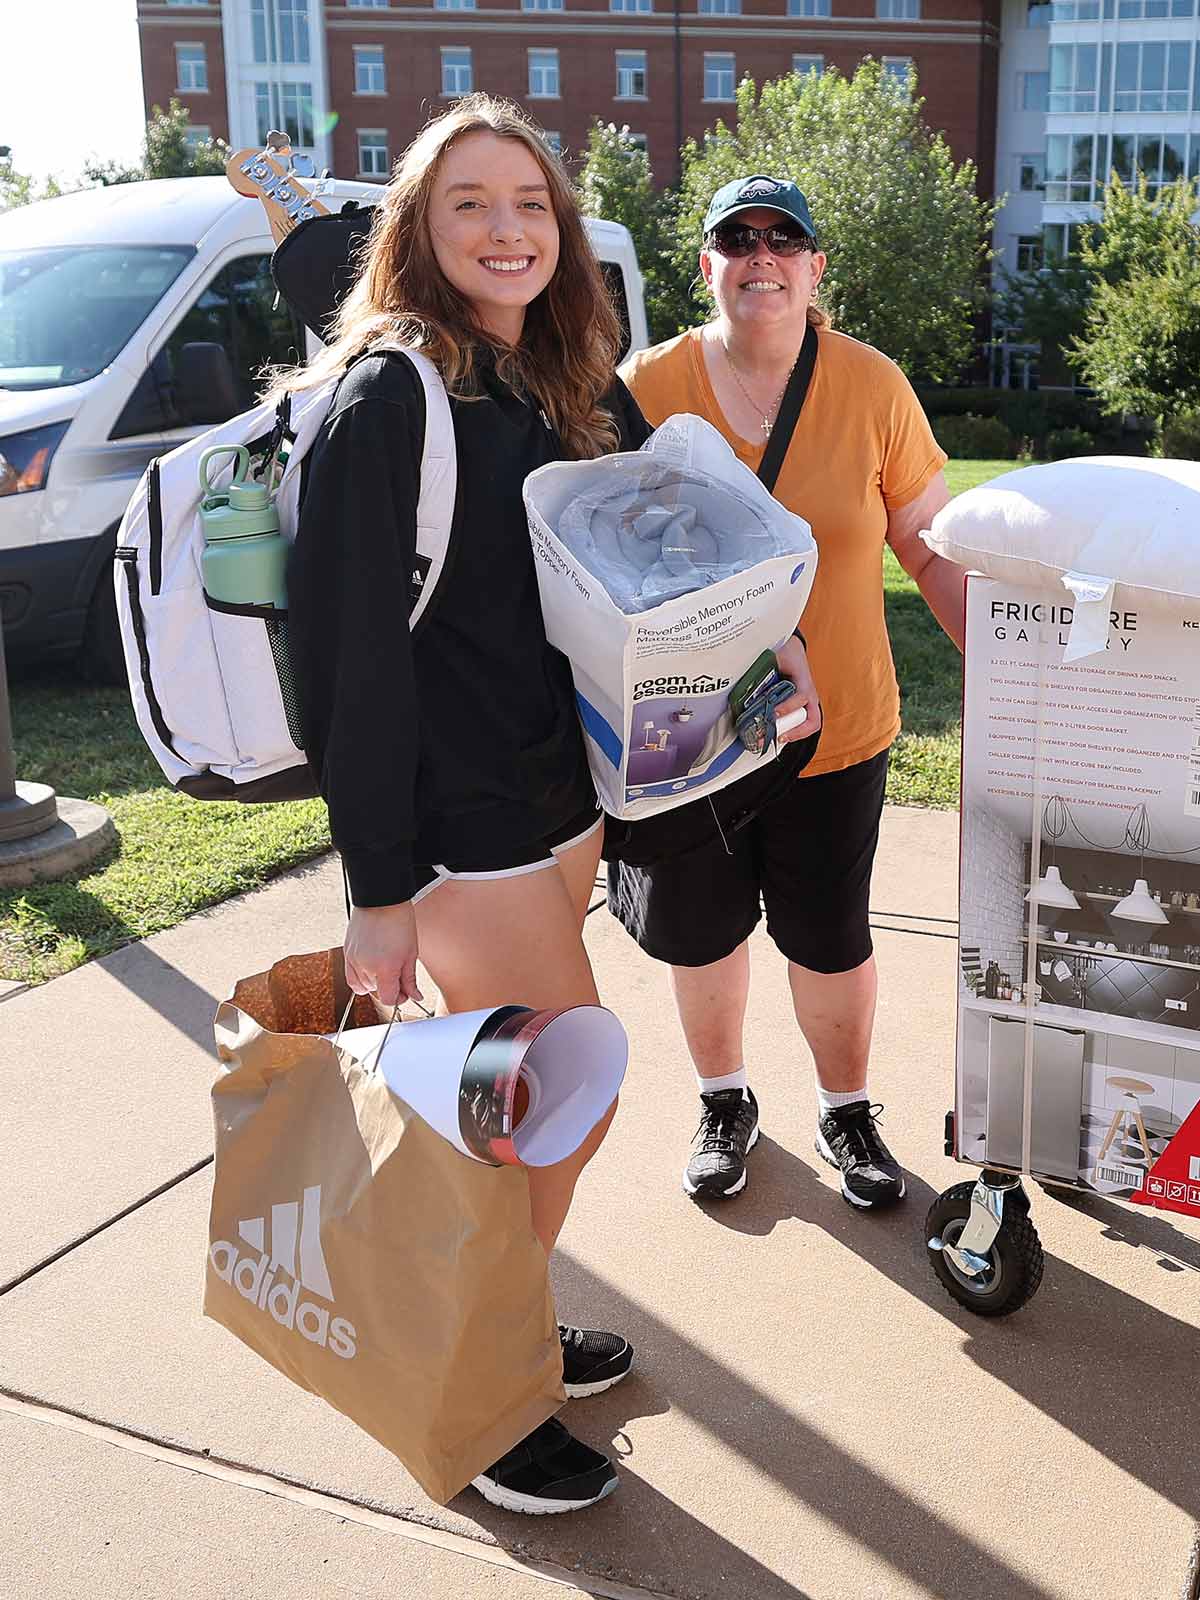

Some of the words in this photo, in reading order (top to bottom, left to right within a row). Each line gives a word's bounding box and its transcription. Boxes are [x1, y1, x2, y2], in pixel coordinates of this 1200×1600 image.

[536, 542, 560, 574] Topper
[544, 536, 572, 576] Memory
[570, 570, 591, 600] Foam
[637, 614, 698, 636] Reversible
[698, 595, 744, 620] Memory
[745, 580, 774, 600] Foam
[991, 601, 1137, 631] FRIGIDRE
[636, 634, 692, 643] Mattress
[695, 614, 732, 637] Topper
[994, 626, 1132, 651] GALLY
[633, 677, 730, 700] essentials
[634, 675, 687, 692] room
[1004, 679, 1029, 687] DURABLE
[1089, 687, 1122, 696] ORGANIZED
[1137, 692, 1183, 702] SOPHISTICATED
[1123, 709, 1168, 720] ORGANIZATION
[988, 733, 1016, 741] EQUIPPED
[1088, 744, 1112, 752] SHELVES
[1126, 749, 1160, 757] ORGANIZED
[988, 751, 1010, 759] CHILLER
[1097, 782, 1126, 791] SEAMLESS
[209, 1240, 357, 1359] adidas
